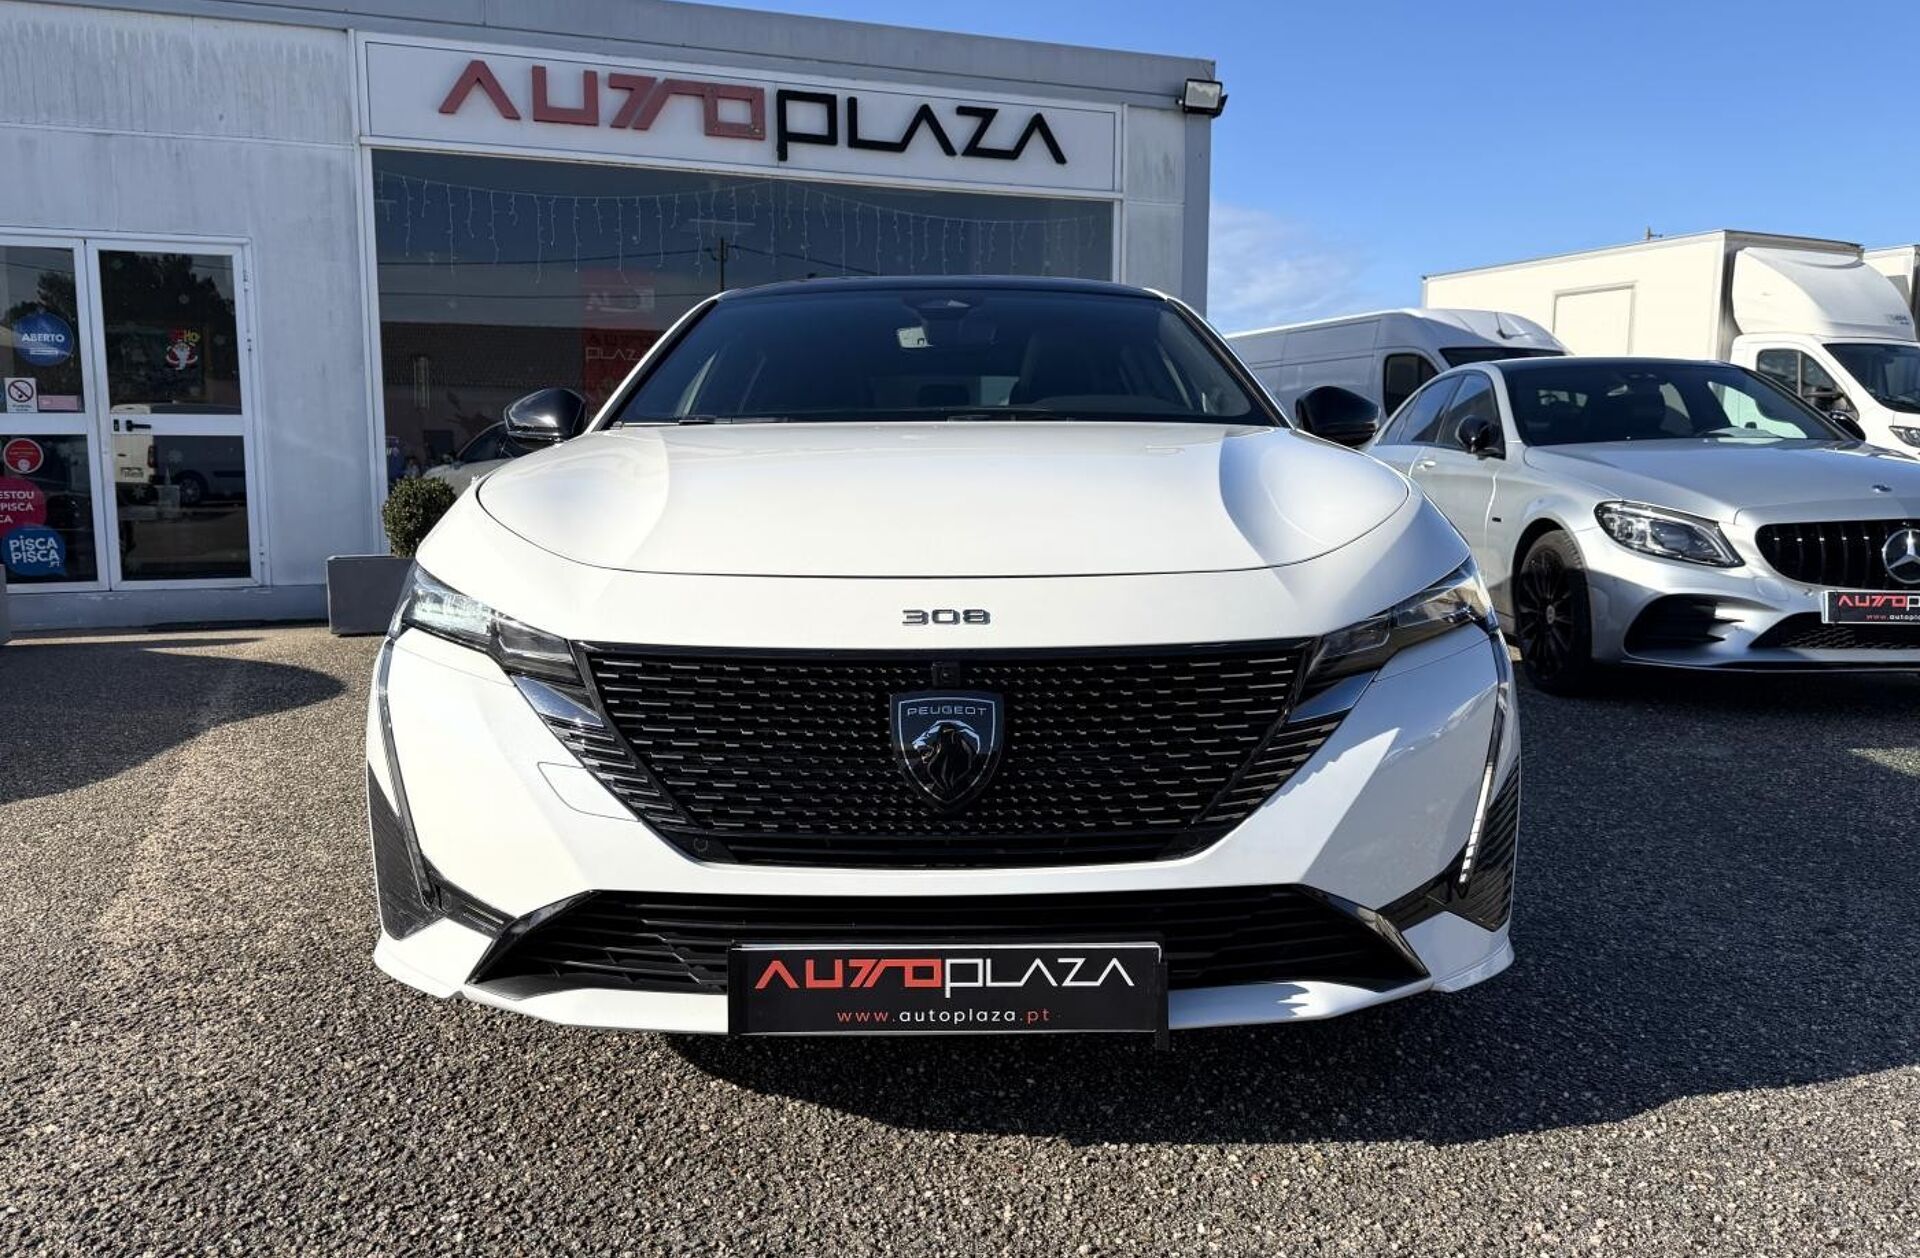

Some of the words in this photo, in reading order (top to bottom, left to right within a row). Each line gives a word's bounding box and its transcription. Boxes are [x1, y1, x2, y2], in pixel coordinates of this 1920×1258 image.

[21, 333, 65, 343] ABERTO
[0, 502, 34, 512] PISCA
[902, 609, 991, 625] 308
[906, 706, 988, 716] PEUGEOT
[836, 1008, 1051, 1025] www.autoplaza.pt
